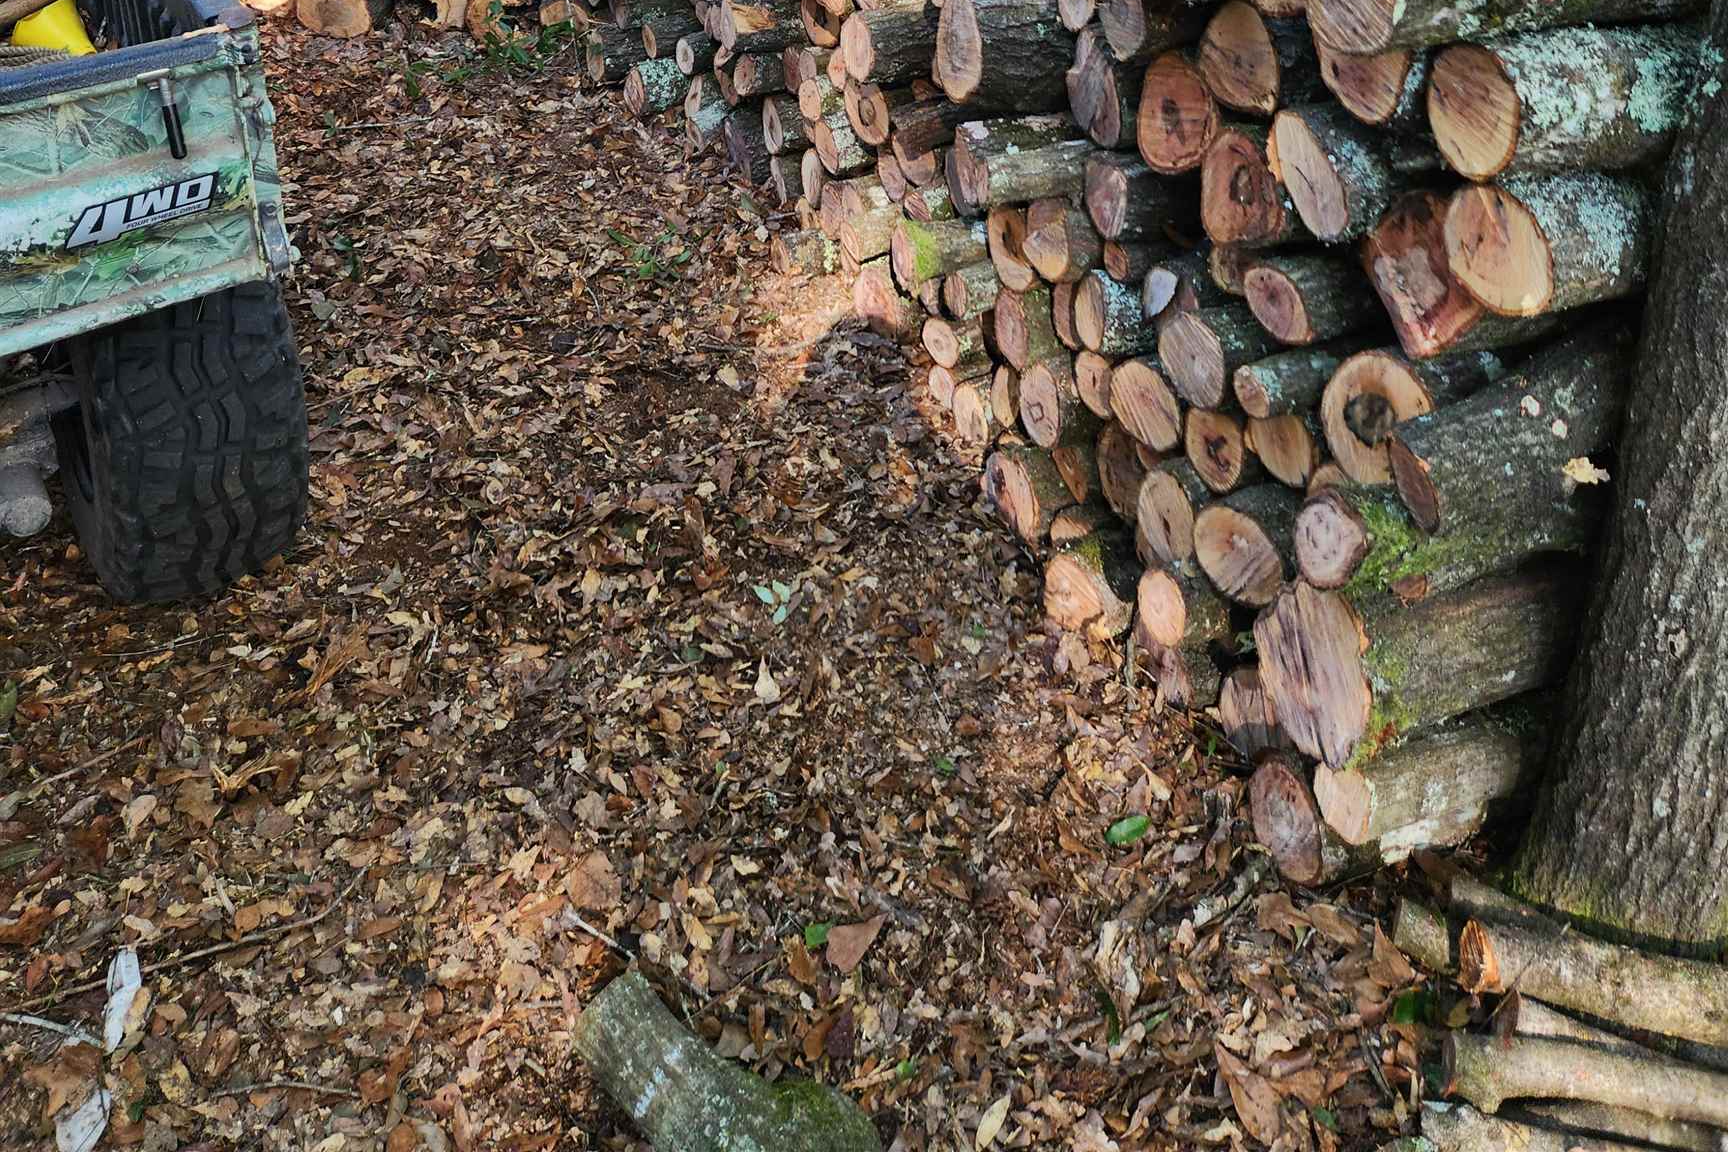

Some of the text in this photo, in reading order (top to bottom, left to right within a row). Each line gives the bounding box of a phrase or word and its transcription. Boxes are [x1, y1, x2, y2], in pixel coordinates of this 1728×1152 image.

[67, 174, 214, 248] 4WD
[126, 204, 202, 229] FOUR WHEEL DRIVE
